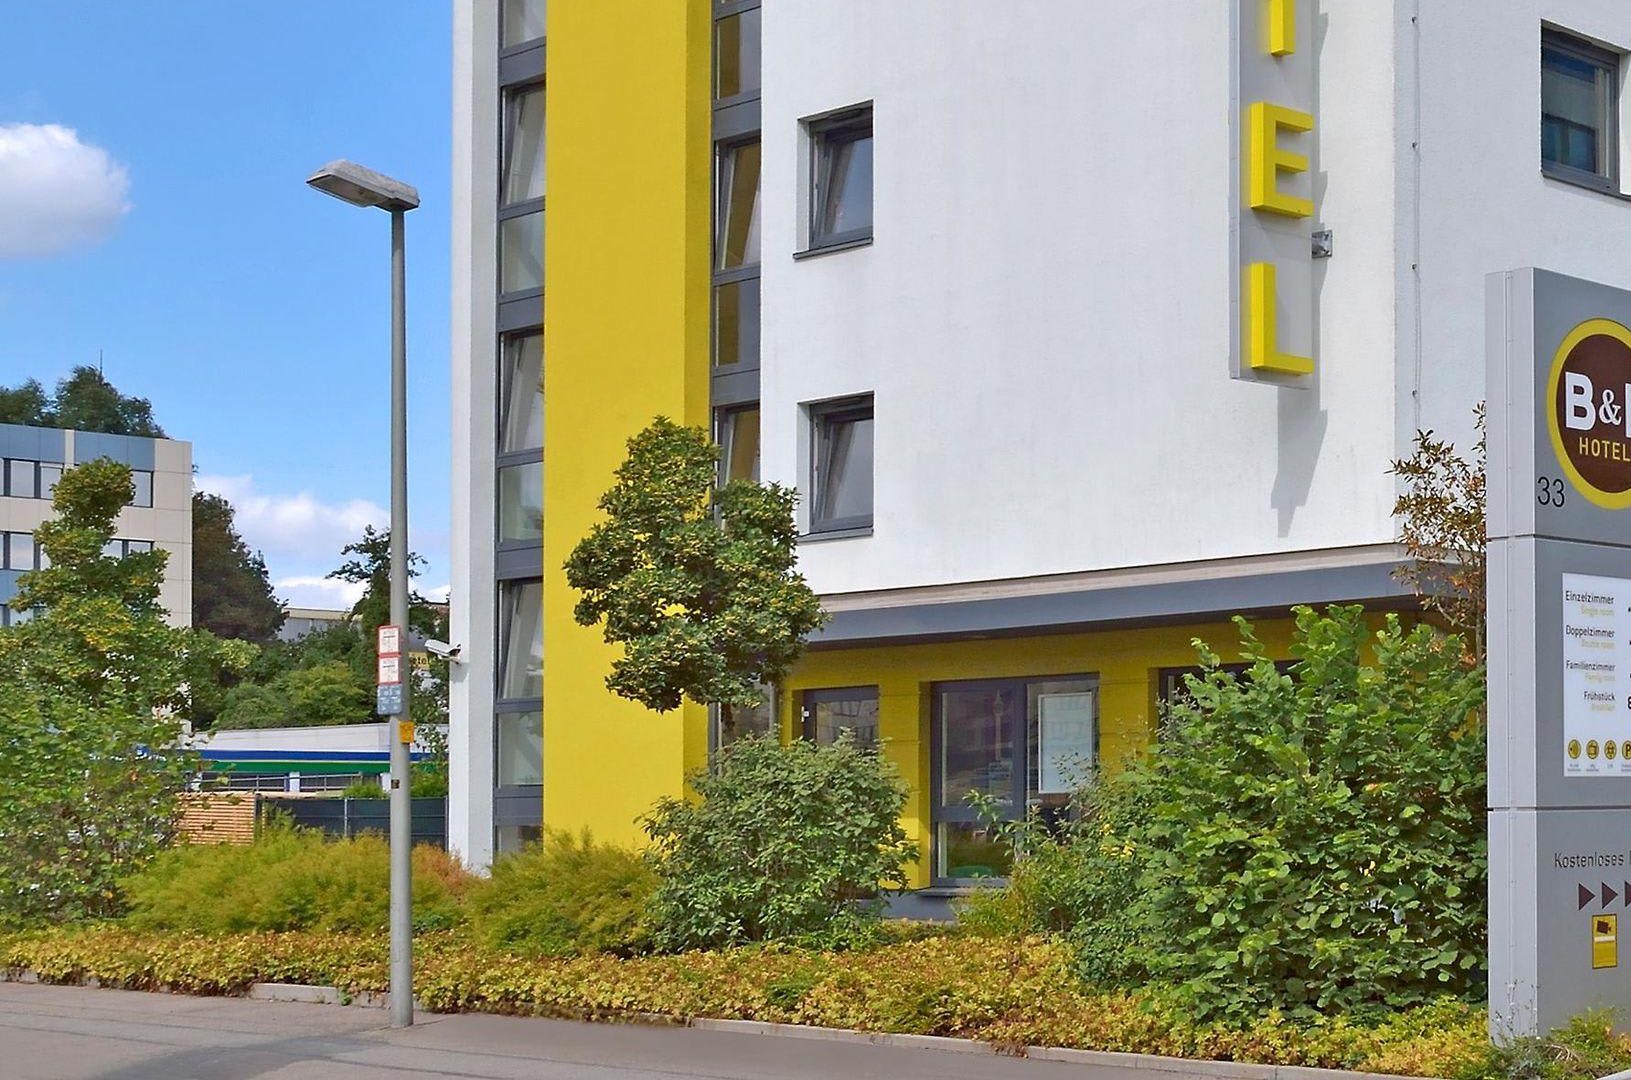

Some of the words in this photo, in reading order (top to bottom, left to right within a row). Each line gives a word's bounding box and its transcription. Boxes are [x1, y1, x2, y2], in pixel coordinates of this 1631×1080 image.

[1537, 476, 1565, 508] 33
[1565, 590, 1615, 605] Einzelzimmer
[1565, 624, 1615, 639] Doppelzimmer
[1566, 659, 1616, 672] Familienzimmer
[1583, 690, 1616, 702] Frühstück
[1554, 851, 1625, 869] Kostenloses
